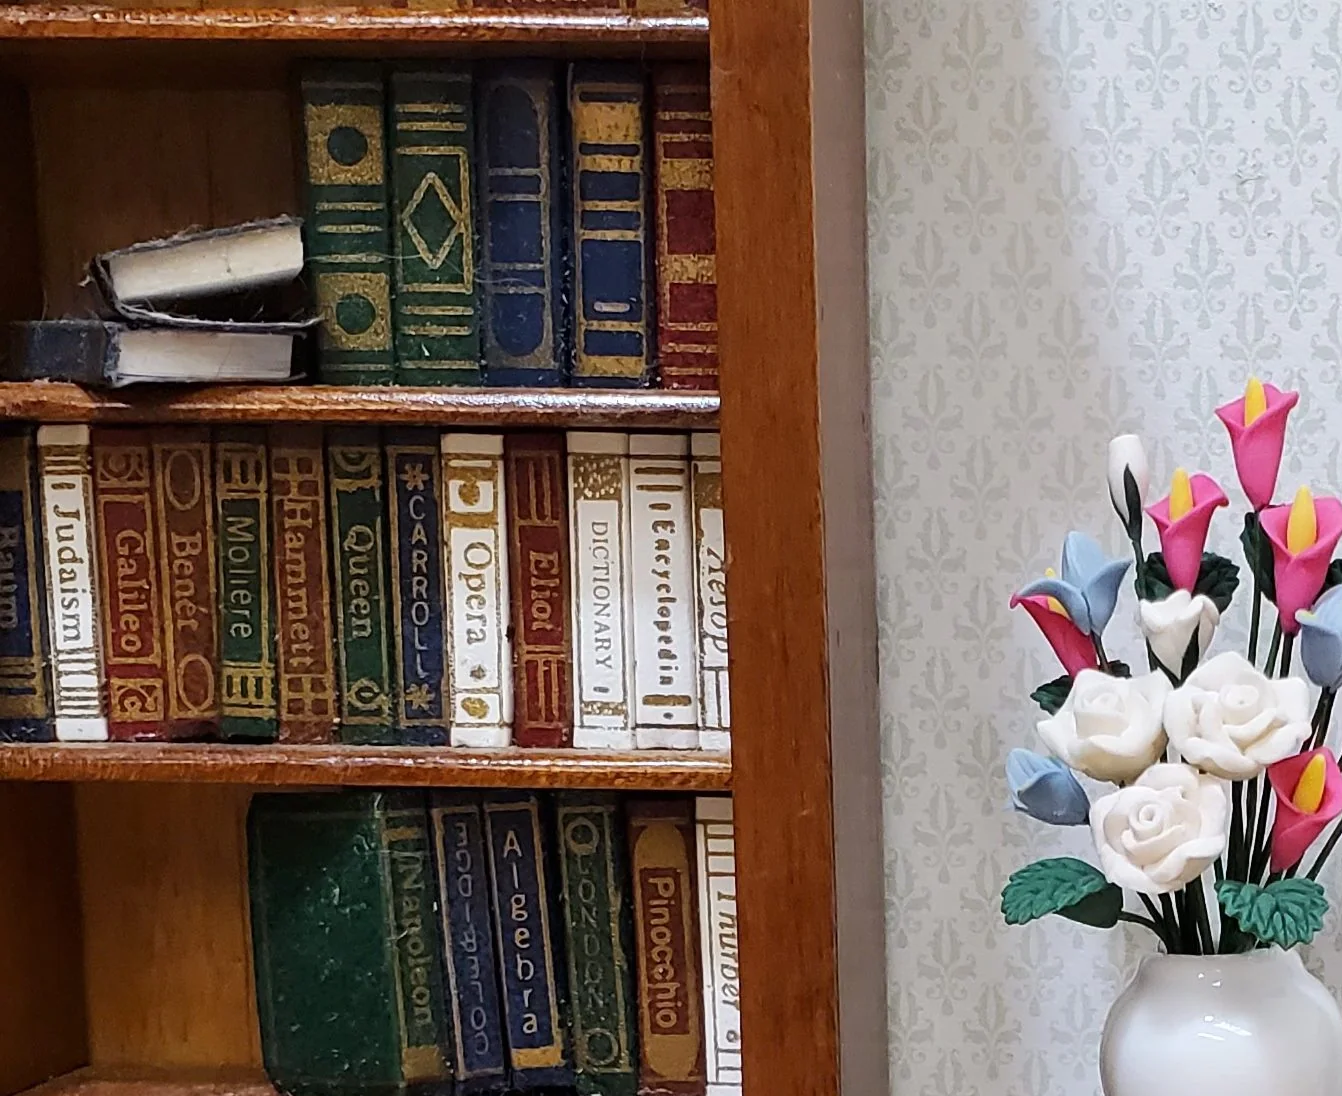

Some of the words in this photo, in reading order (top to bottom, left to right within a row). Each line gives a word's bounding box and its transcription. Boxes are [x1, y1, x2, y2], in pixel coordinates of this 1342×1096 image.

[51, 504, 88, 643] Judaism
[114, 529, 150, 652] Galileo
[283, 500, 315, 669] Hammett
[343, 524, 374, 640] Queen
[409, 495, 432, 680] CARROLL
[458, 541, 493, 645] Opera
[530, 550, 561, 632] Eliot
[589, 520, 615, 670] DICTIONARY
[504, 829, 538, 1034] Algebra
[647, 876, 680, 1029] Pinocchio
